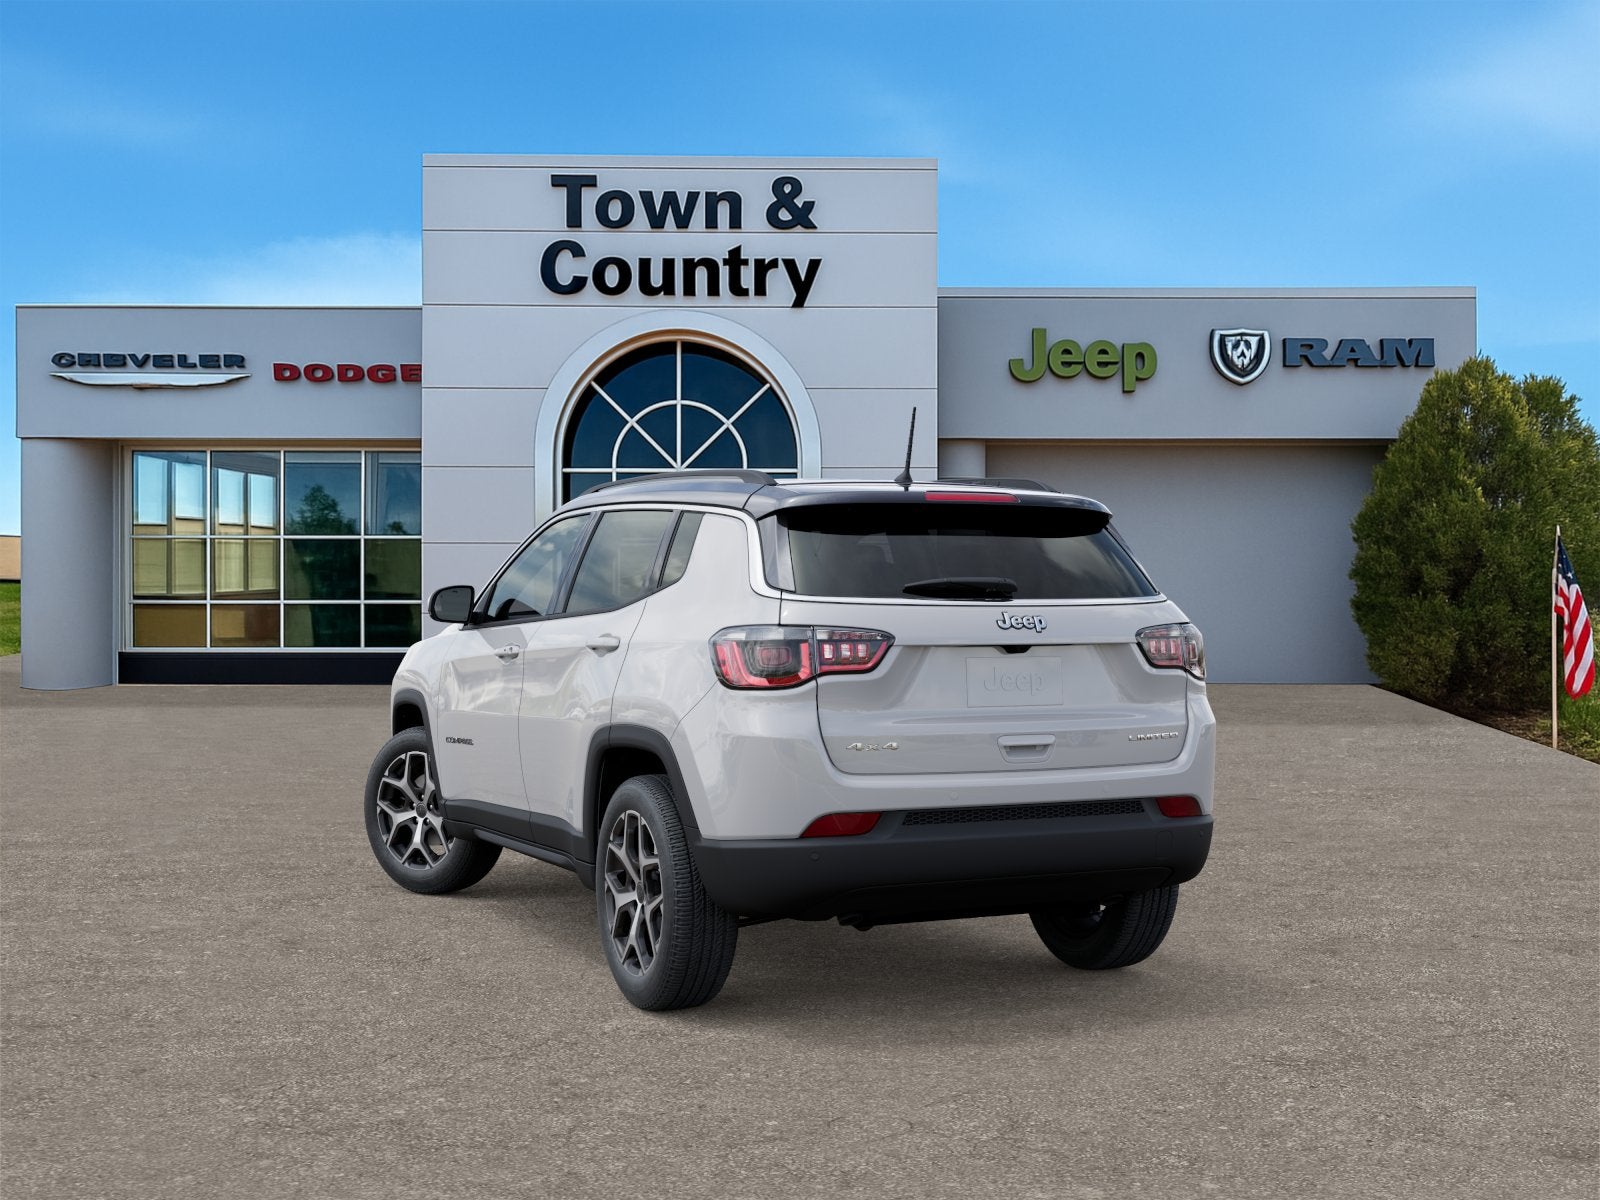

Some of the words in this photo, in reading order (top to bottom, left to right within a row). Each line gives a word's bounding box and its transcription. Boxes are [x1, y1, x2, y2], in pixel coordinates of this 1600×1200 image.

[550, 174, 742, 229] Town
[765, 175, 818, 230] &
[540, 239, 822, 308] Country
[1009, 327, 1157, 393] Jeep
[1282, 337, 1435, 368] RAM
[273, 363, 422, 383] DODGE
[996, 611, 1048, 633] Jeep
[983, 666, 1048, 697] Jeep
